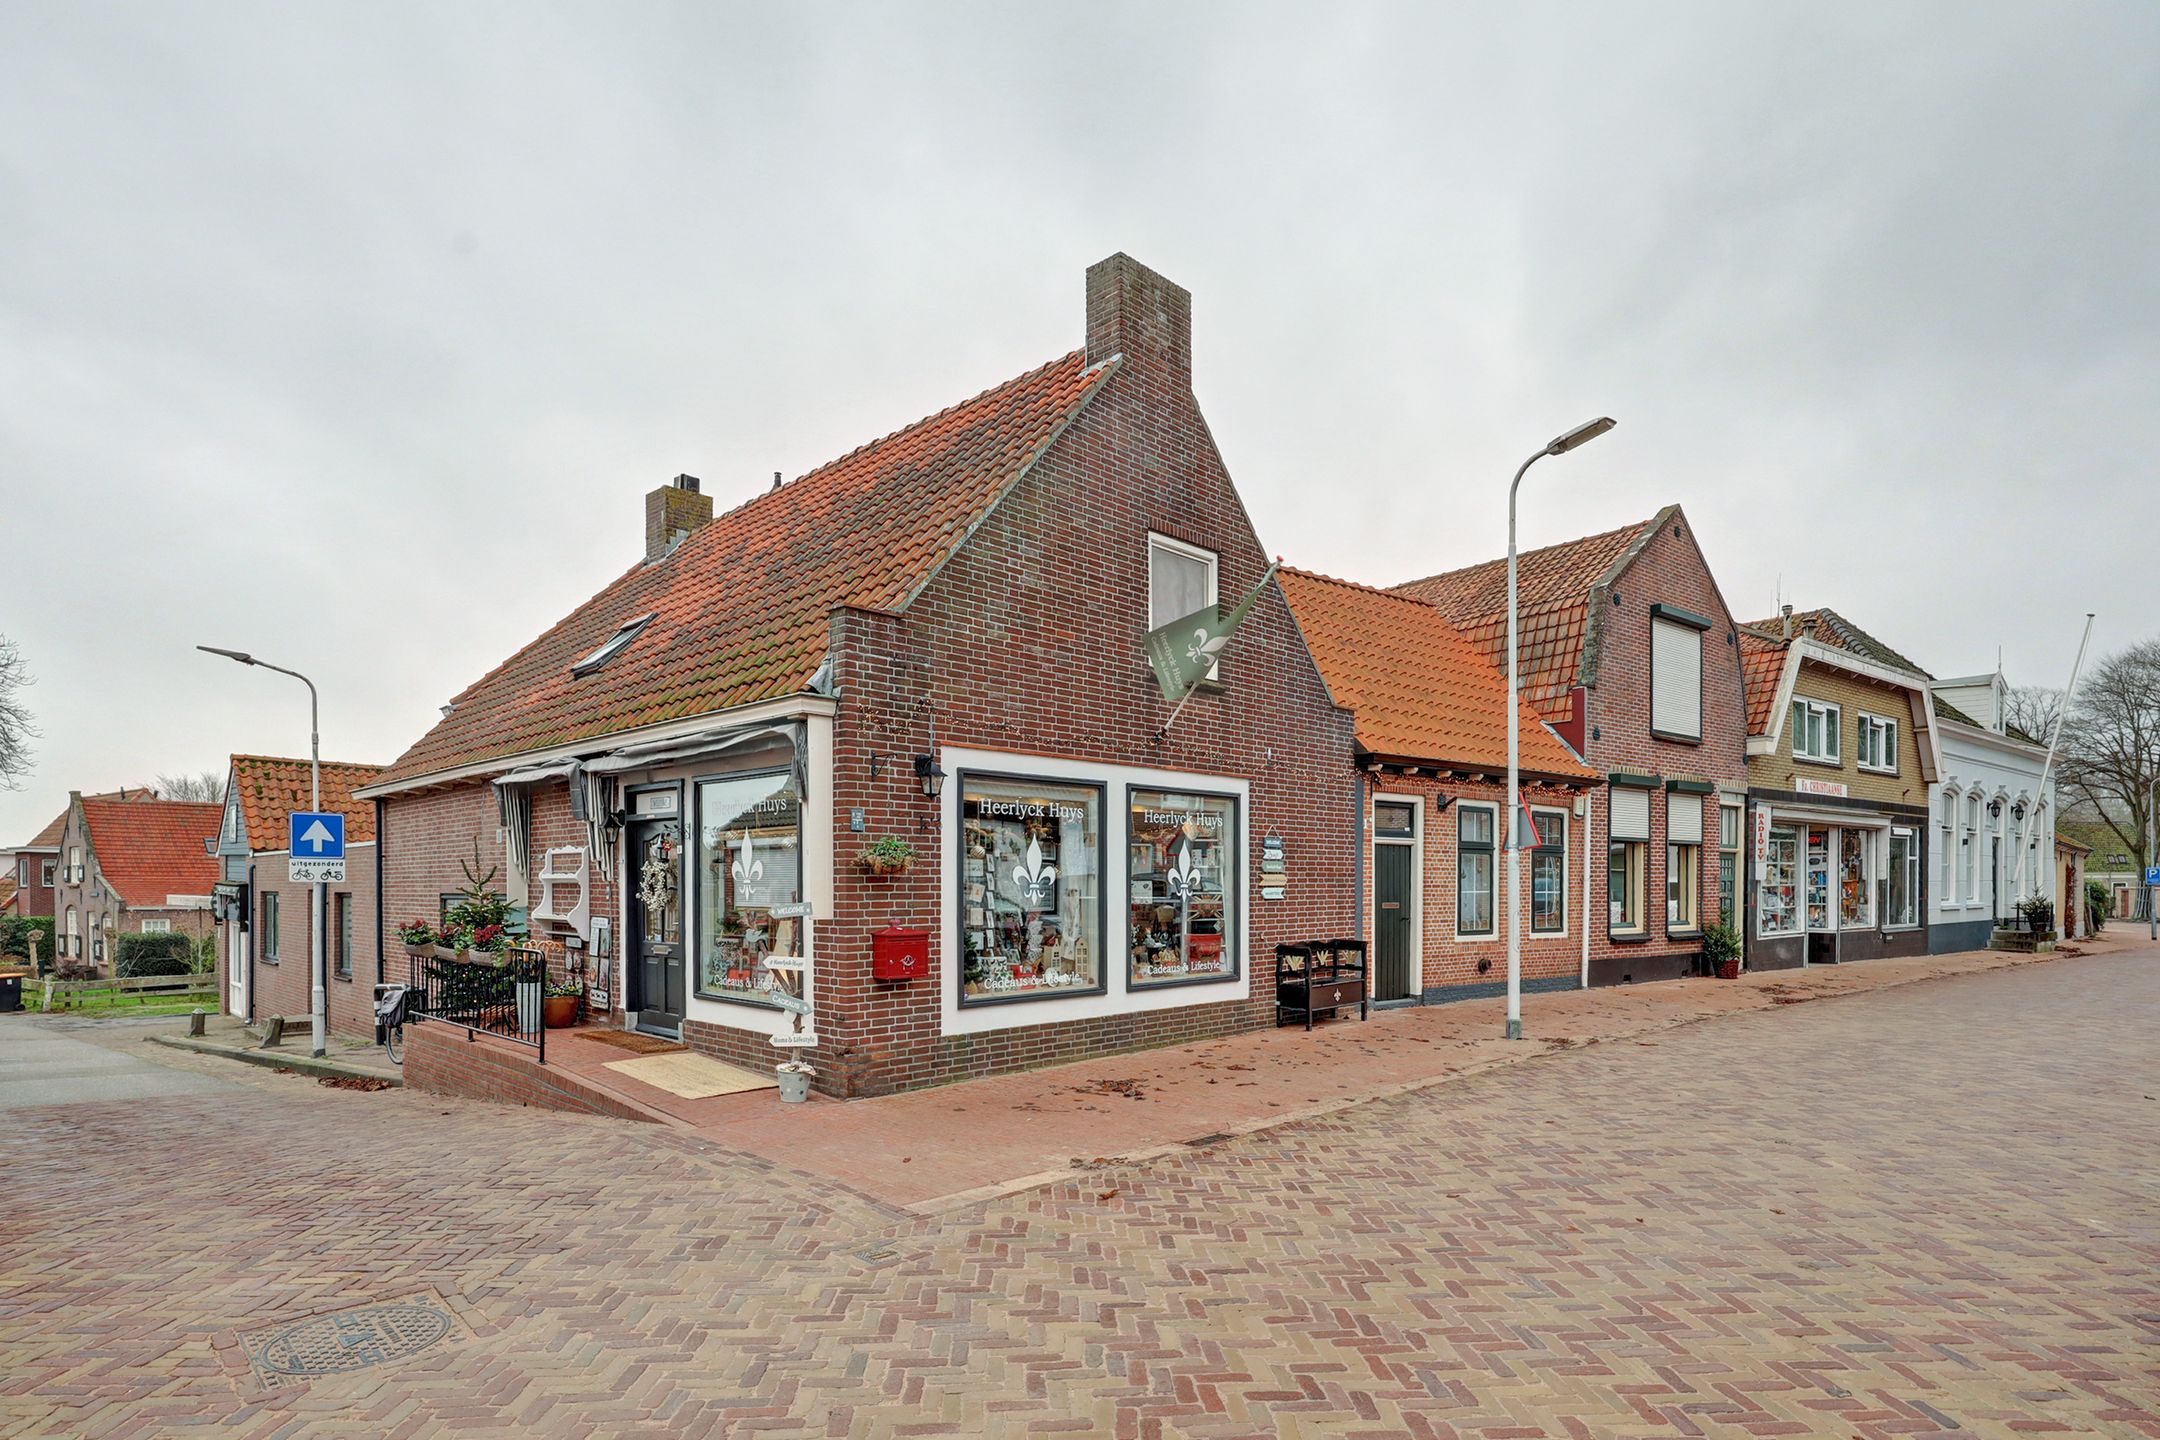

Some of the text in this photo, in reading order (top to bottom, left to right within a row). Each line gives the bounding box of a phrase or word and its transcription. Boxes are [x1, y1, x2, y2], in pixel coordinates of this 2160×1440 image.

[758, 799, 787, 815] Huys
[980, 798, 1084, 822] Heerlyck Huys
[1144, 809, 1223, 829] Heerlyck Huys
[1758, 848, 1765, 860] TV
[2149, 869, 2158, 878] P
[777, 904, 805, 915] WELCOME
[1147, 959, 1221, 975] Cadeaus & Lifestyle
[714, 974, 744, 988] Cadeaus
[984, 975, 1028, 990] Cadeaus
[771, 994, 801, 1010] CADEAUS
